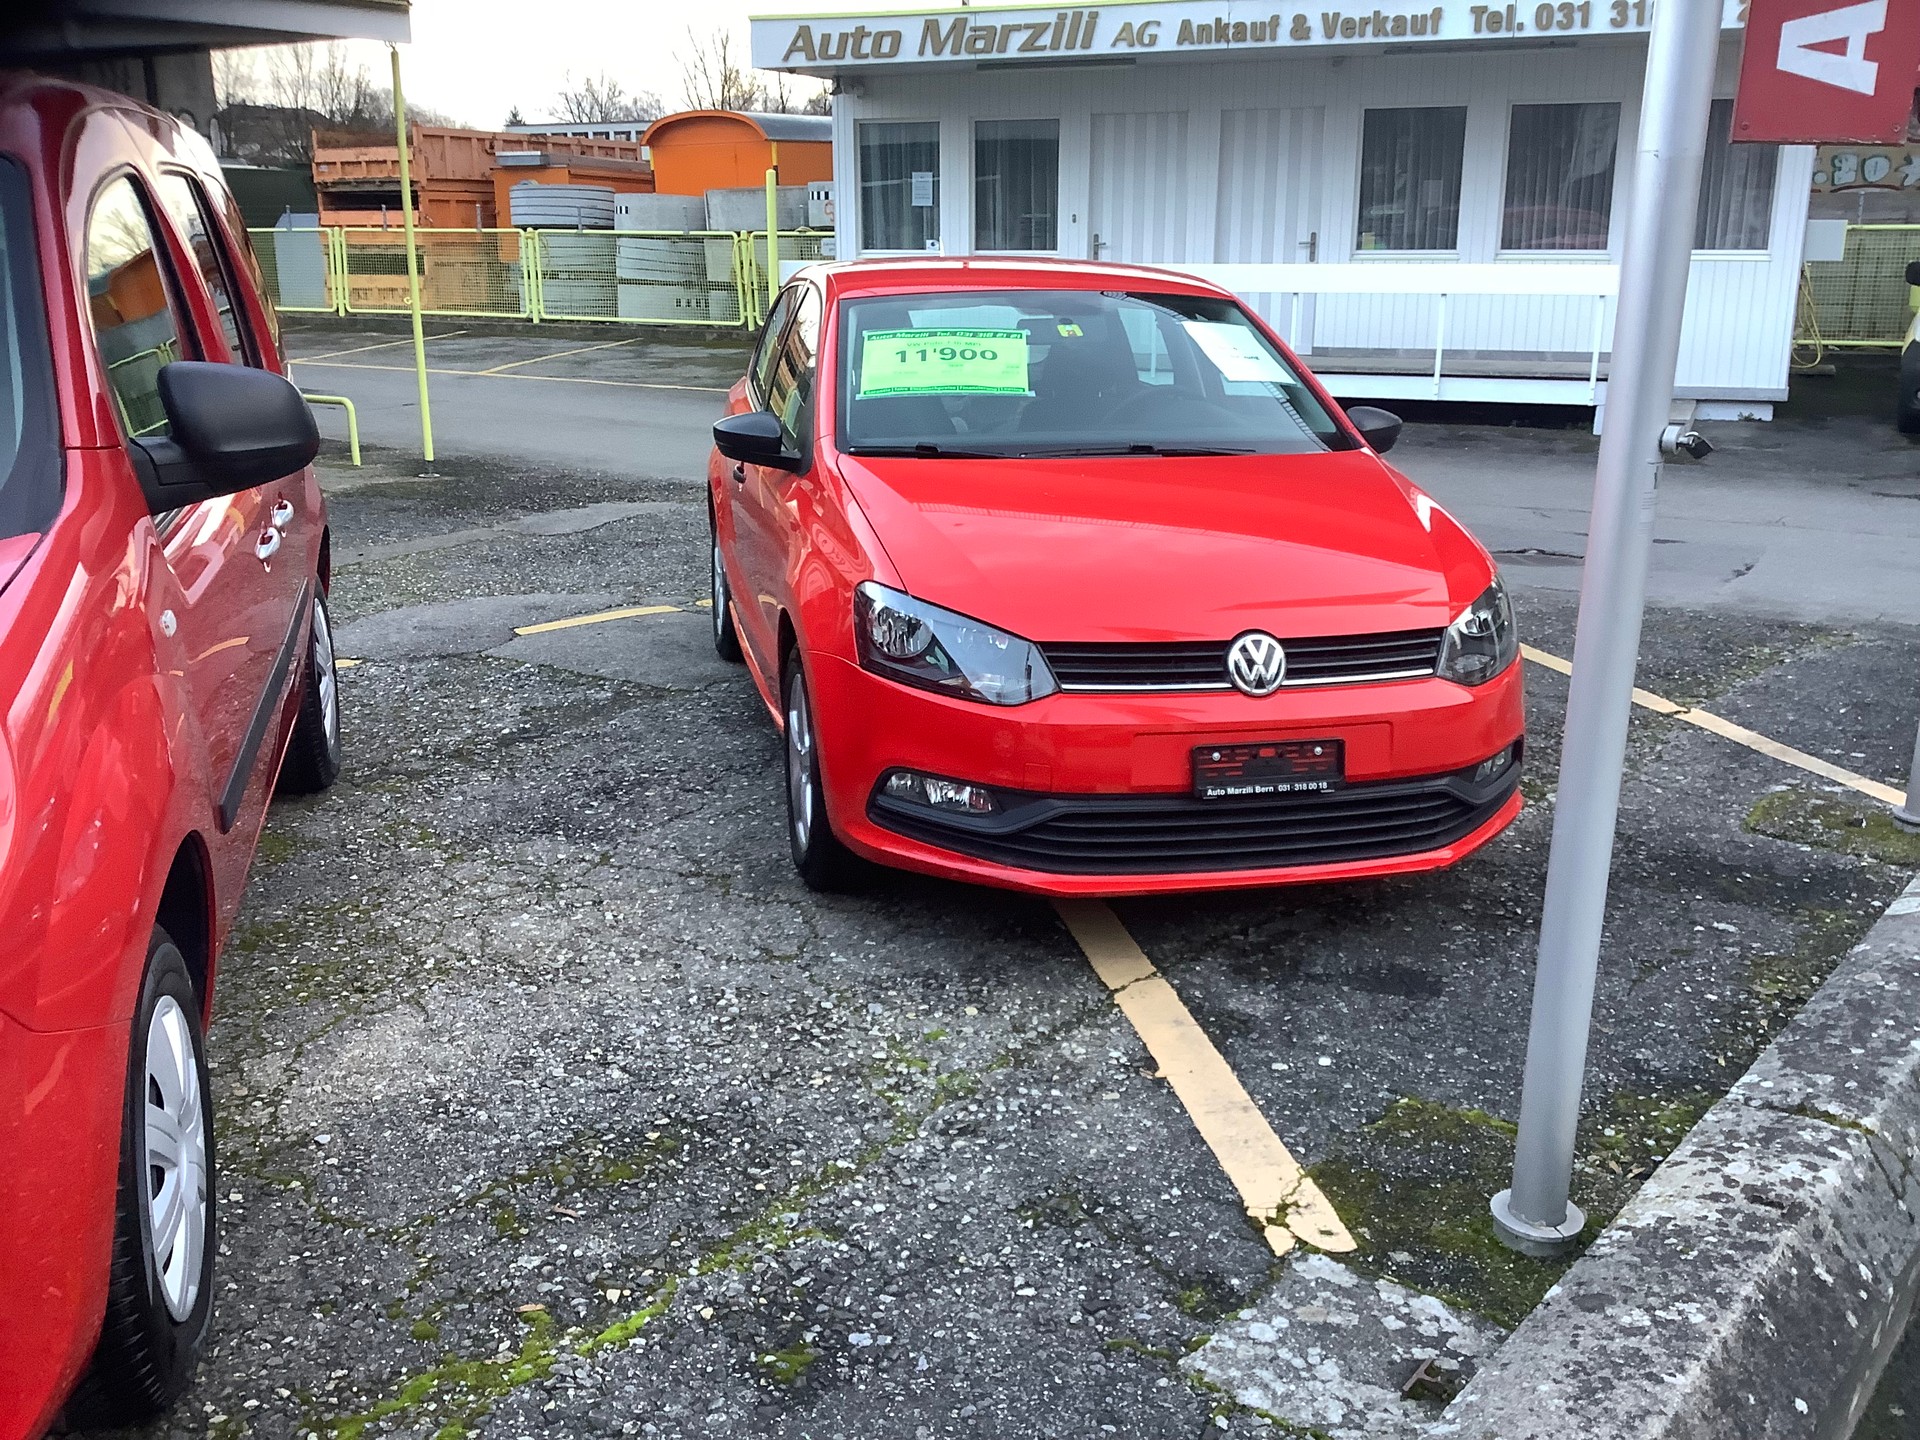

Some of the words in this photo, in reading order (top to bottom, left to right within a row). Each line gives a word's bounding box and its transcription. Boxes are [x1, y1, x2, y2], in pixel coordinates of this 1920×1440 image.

[782, 25, 902, 62] Auto
[918, 11, 1099, 57] Marzili
[1110, 20, 1161, 48] AG
[1176, 14, 1280, 45] Ankauf
[1289, 14, 1311, 40] &
[1321, 7, 1442, 39] Verkauf
[1470, 4, 1524, 33] Tel.
[1535, 0, 1591, 31] 031
[1610, 0, 1652, 28] 31
[895, 346, 998, 362] 11'900
[1228, 634, 1287, 696] VW
[1207, 788, 1226, 796] Auto
[1227, 786, 1253, 795] Marzili
[1255, 785, 1274, 793] Bern
[1278, 784, 1291, 792] 031
[1294, 783, 1307, 791] 318
[1308, 782, 1318, 790] 00
[1319, 781, 1328, 789] 18
